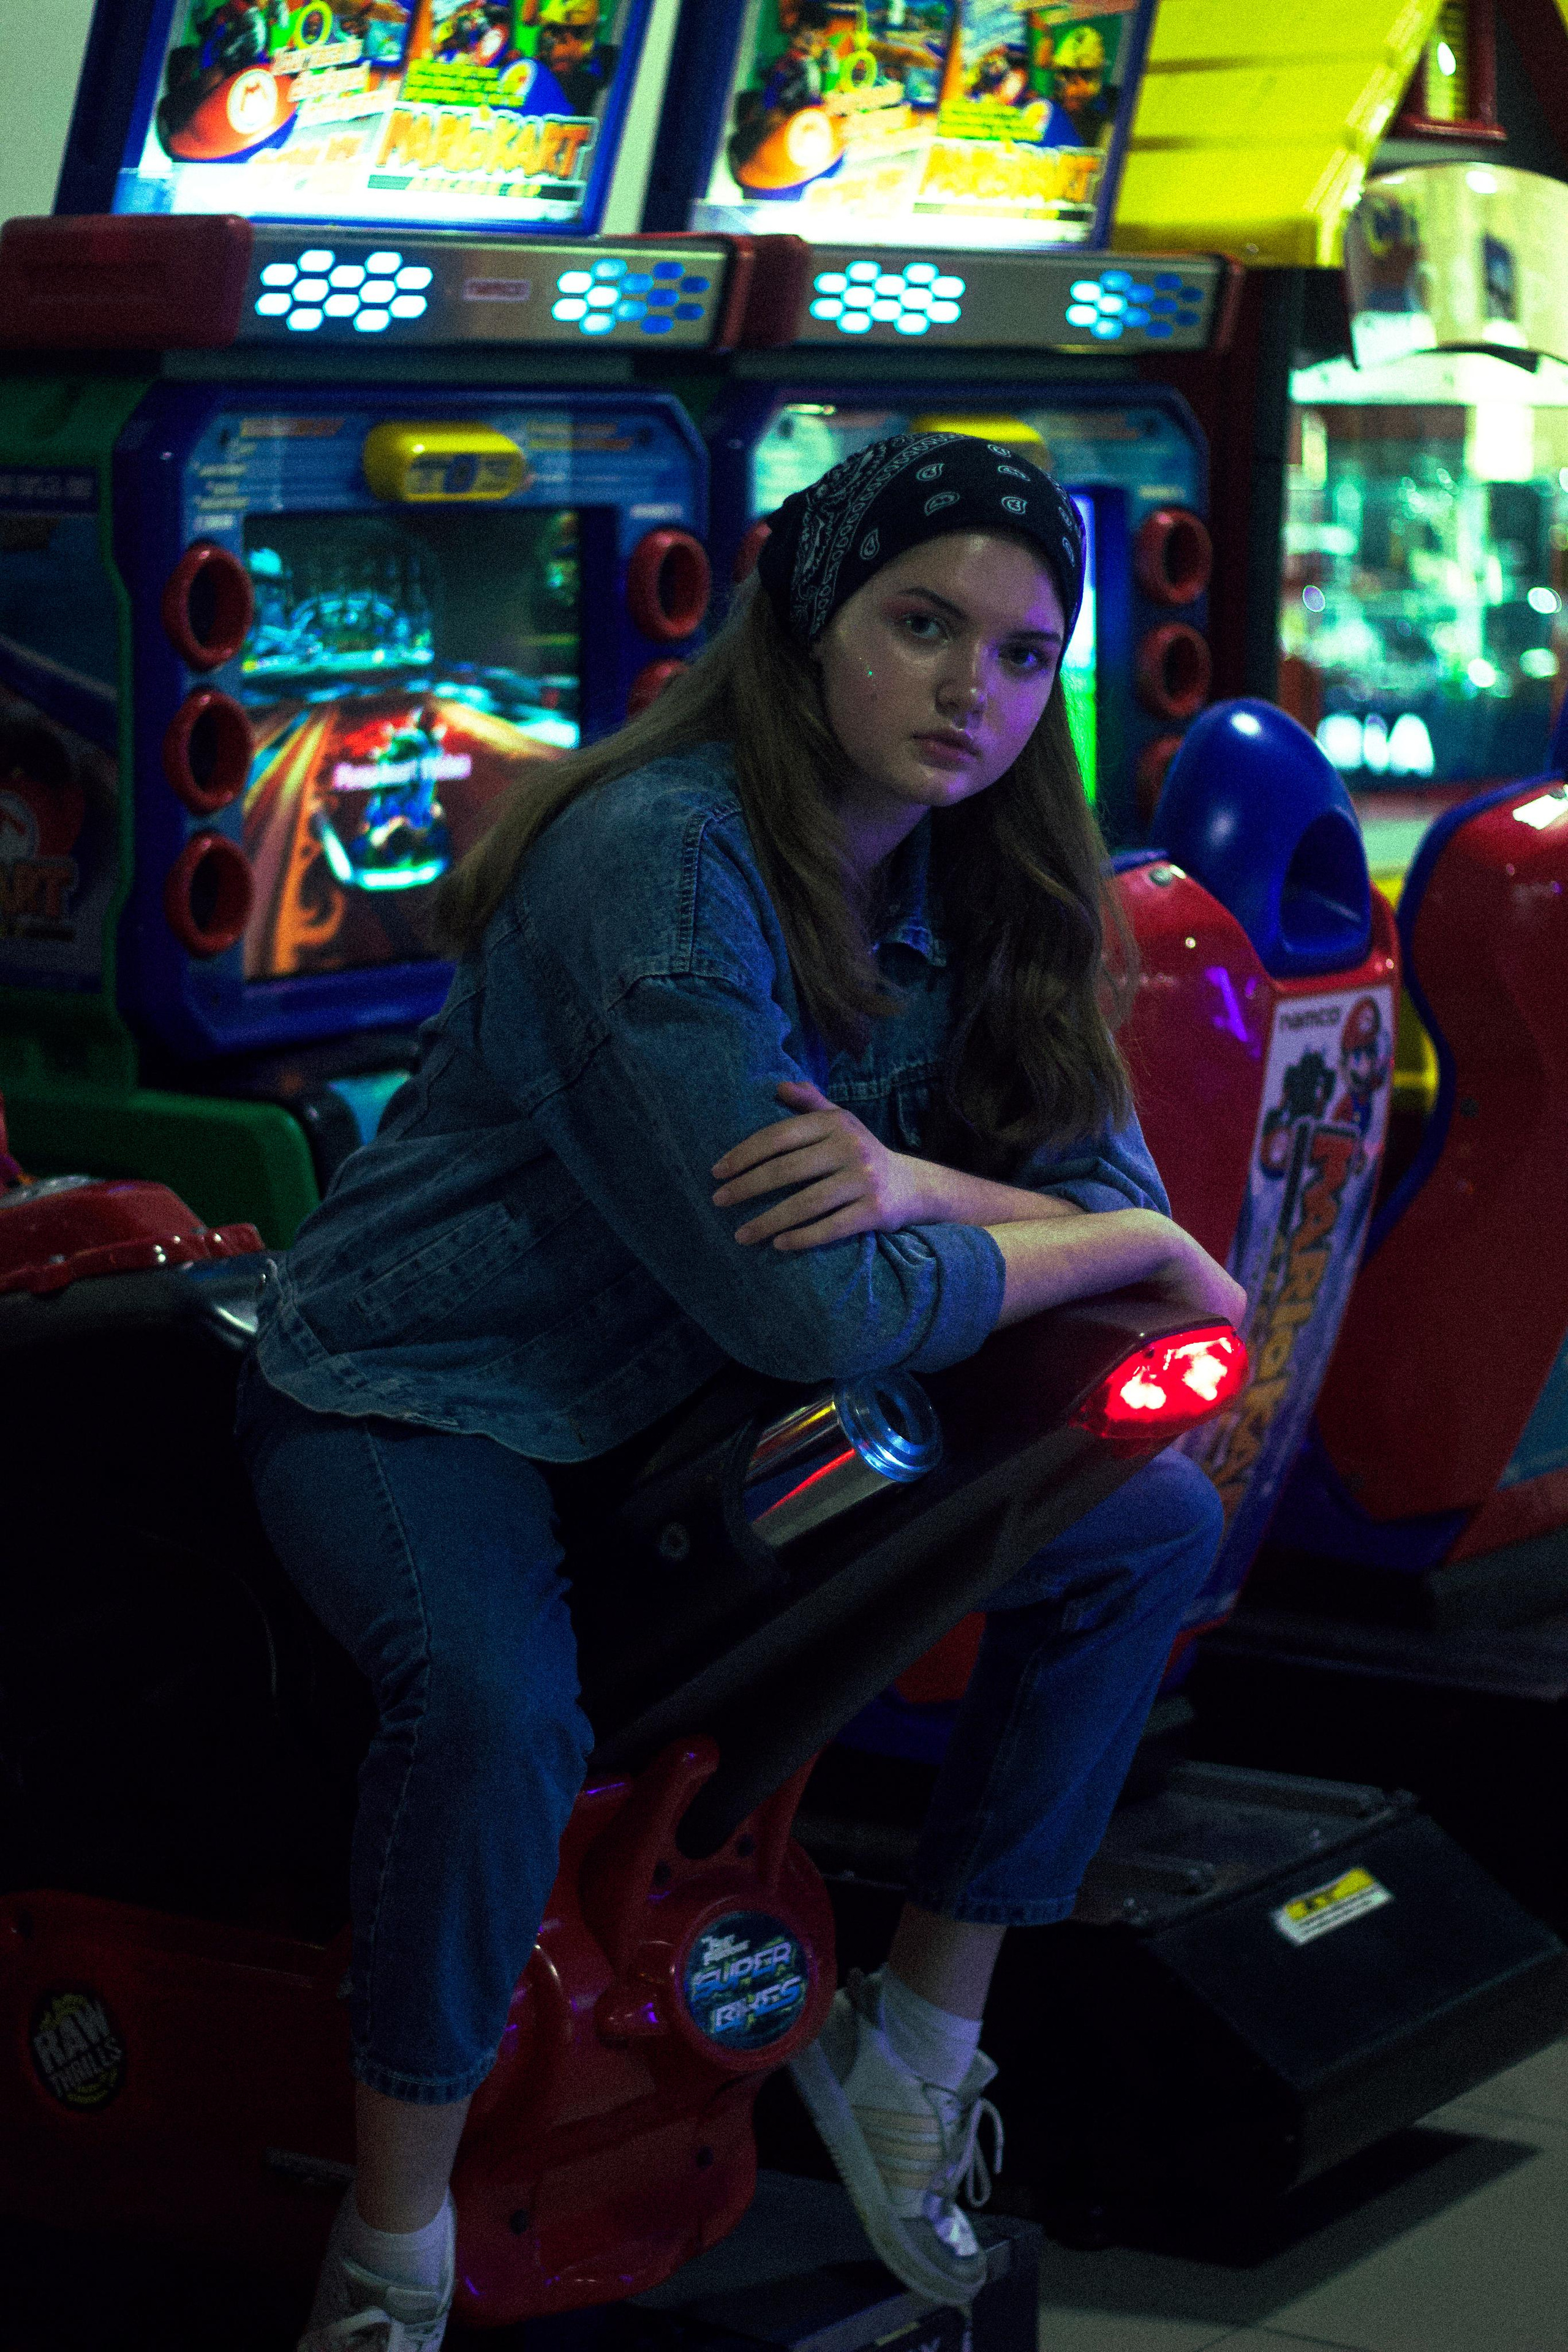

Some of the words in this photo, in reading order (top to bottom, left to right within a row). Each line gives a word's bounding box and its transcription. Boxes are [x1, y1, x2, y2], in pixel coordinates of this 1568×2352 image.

[485, 114, 591, 178] KART
[1259, 1134, 1355, 1378] MARIO
[692, 1940, 792, 2002] SUPER
[34, 1999, 111, 2073] RAW
[49, 2036, 124, 2098] THRILLS
